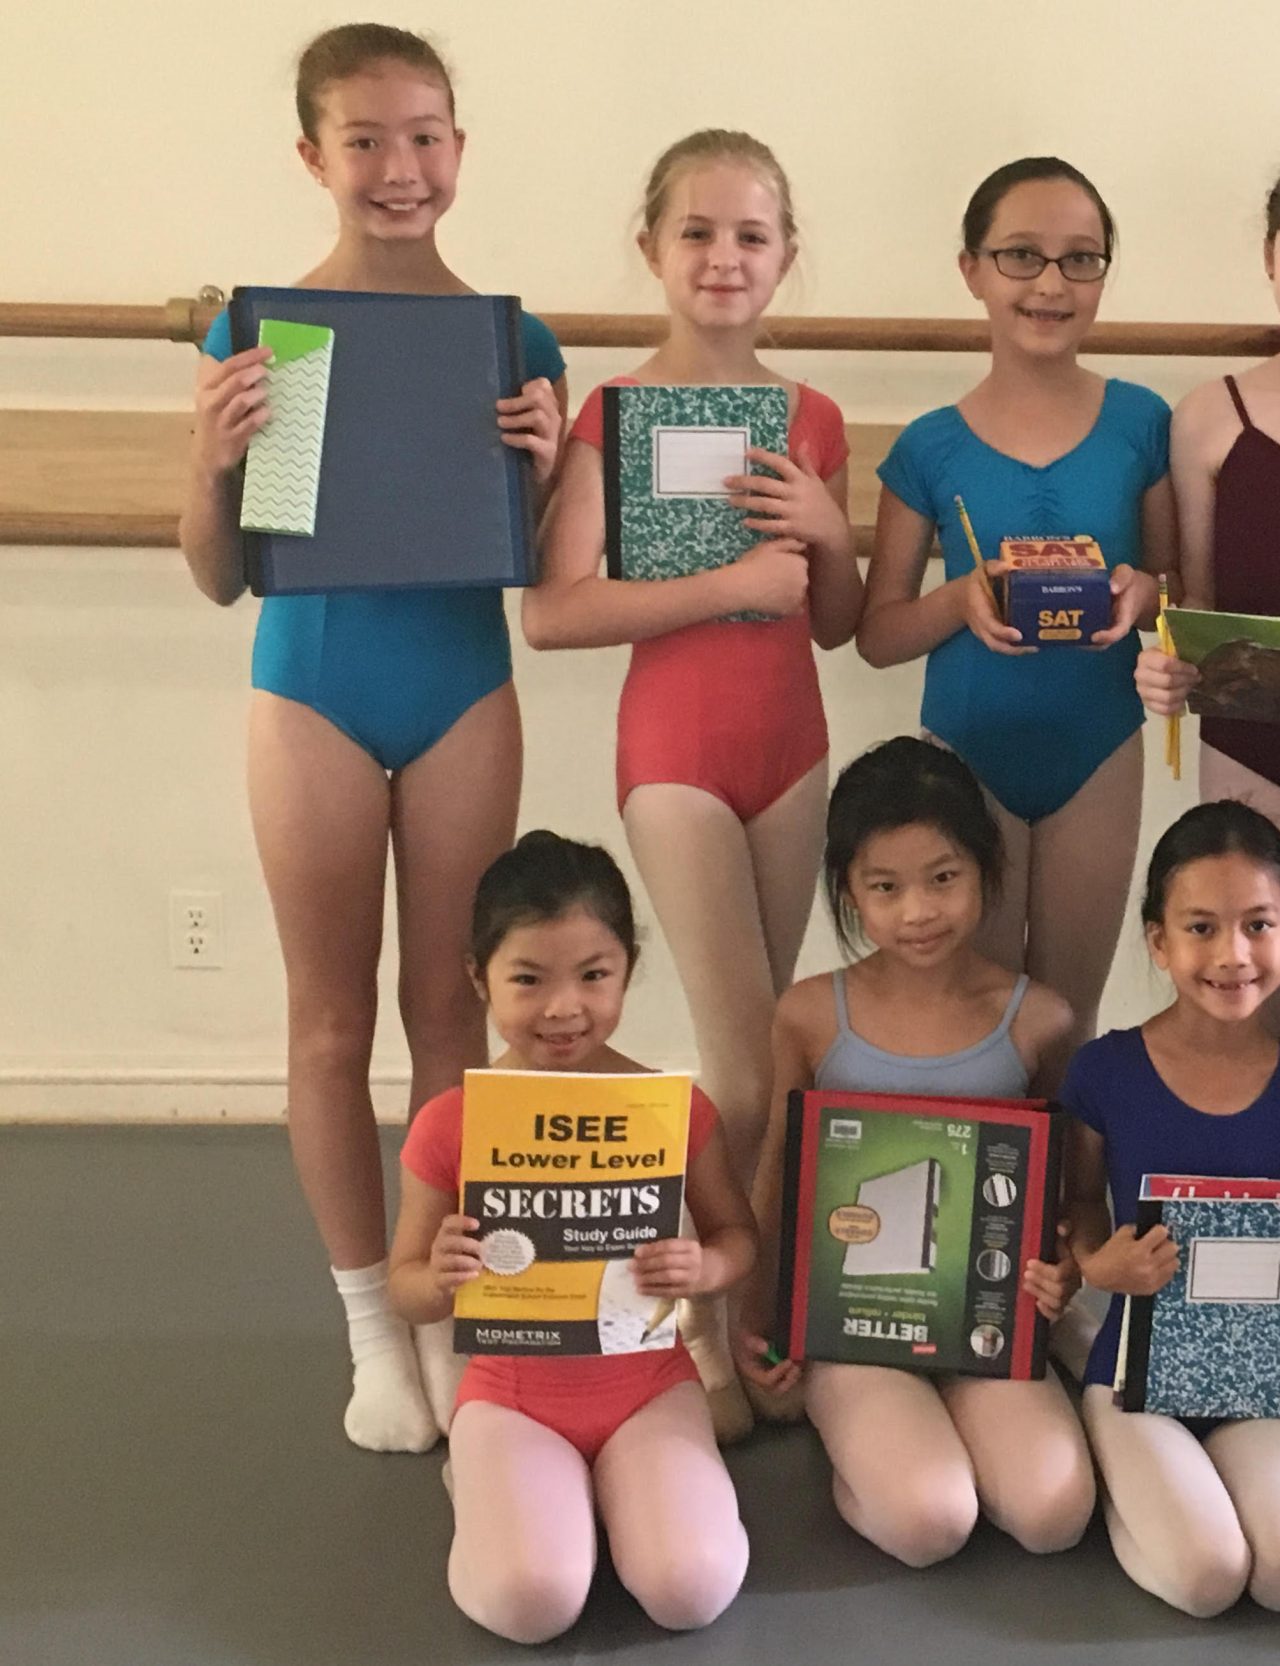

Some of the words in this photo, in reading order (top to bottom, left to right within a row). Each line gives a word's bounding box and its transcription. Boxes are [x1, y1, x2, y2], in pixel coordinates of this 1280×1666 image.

[1009, 543, 1094, 557] SAT
[1038, 610, 1084, 627] SAT
[534, 1114, 628, 1142] ISEE
[491, 1148, 581, 1168] Lower
[590, 1148, 666, 1169] Level
[483, 1184, 660, 1219] SECRETS
[563, 1228, 608, 1244] Study
[612, 1225, 658, 1240] Guide
[476, 1328, 561, 1341] MOMETRIX
[843, 1317, 928, 1343] BETTER
